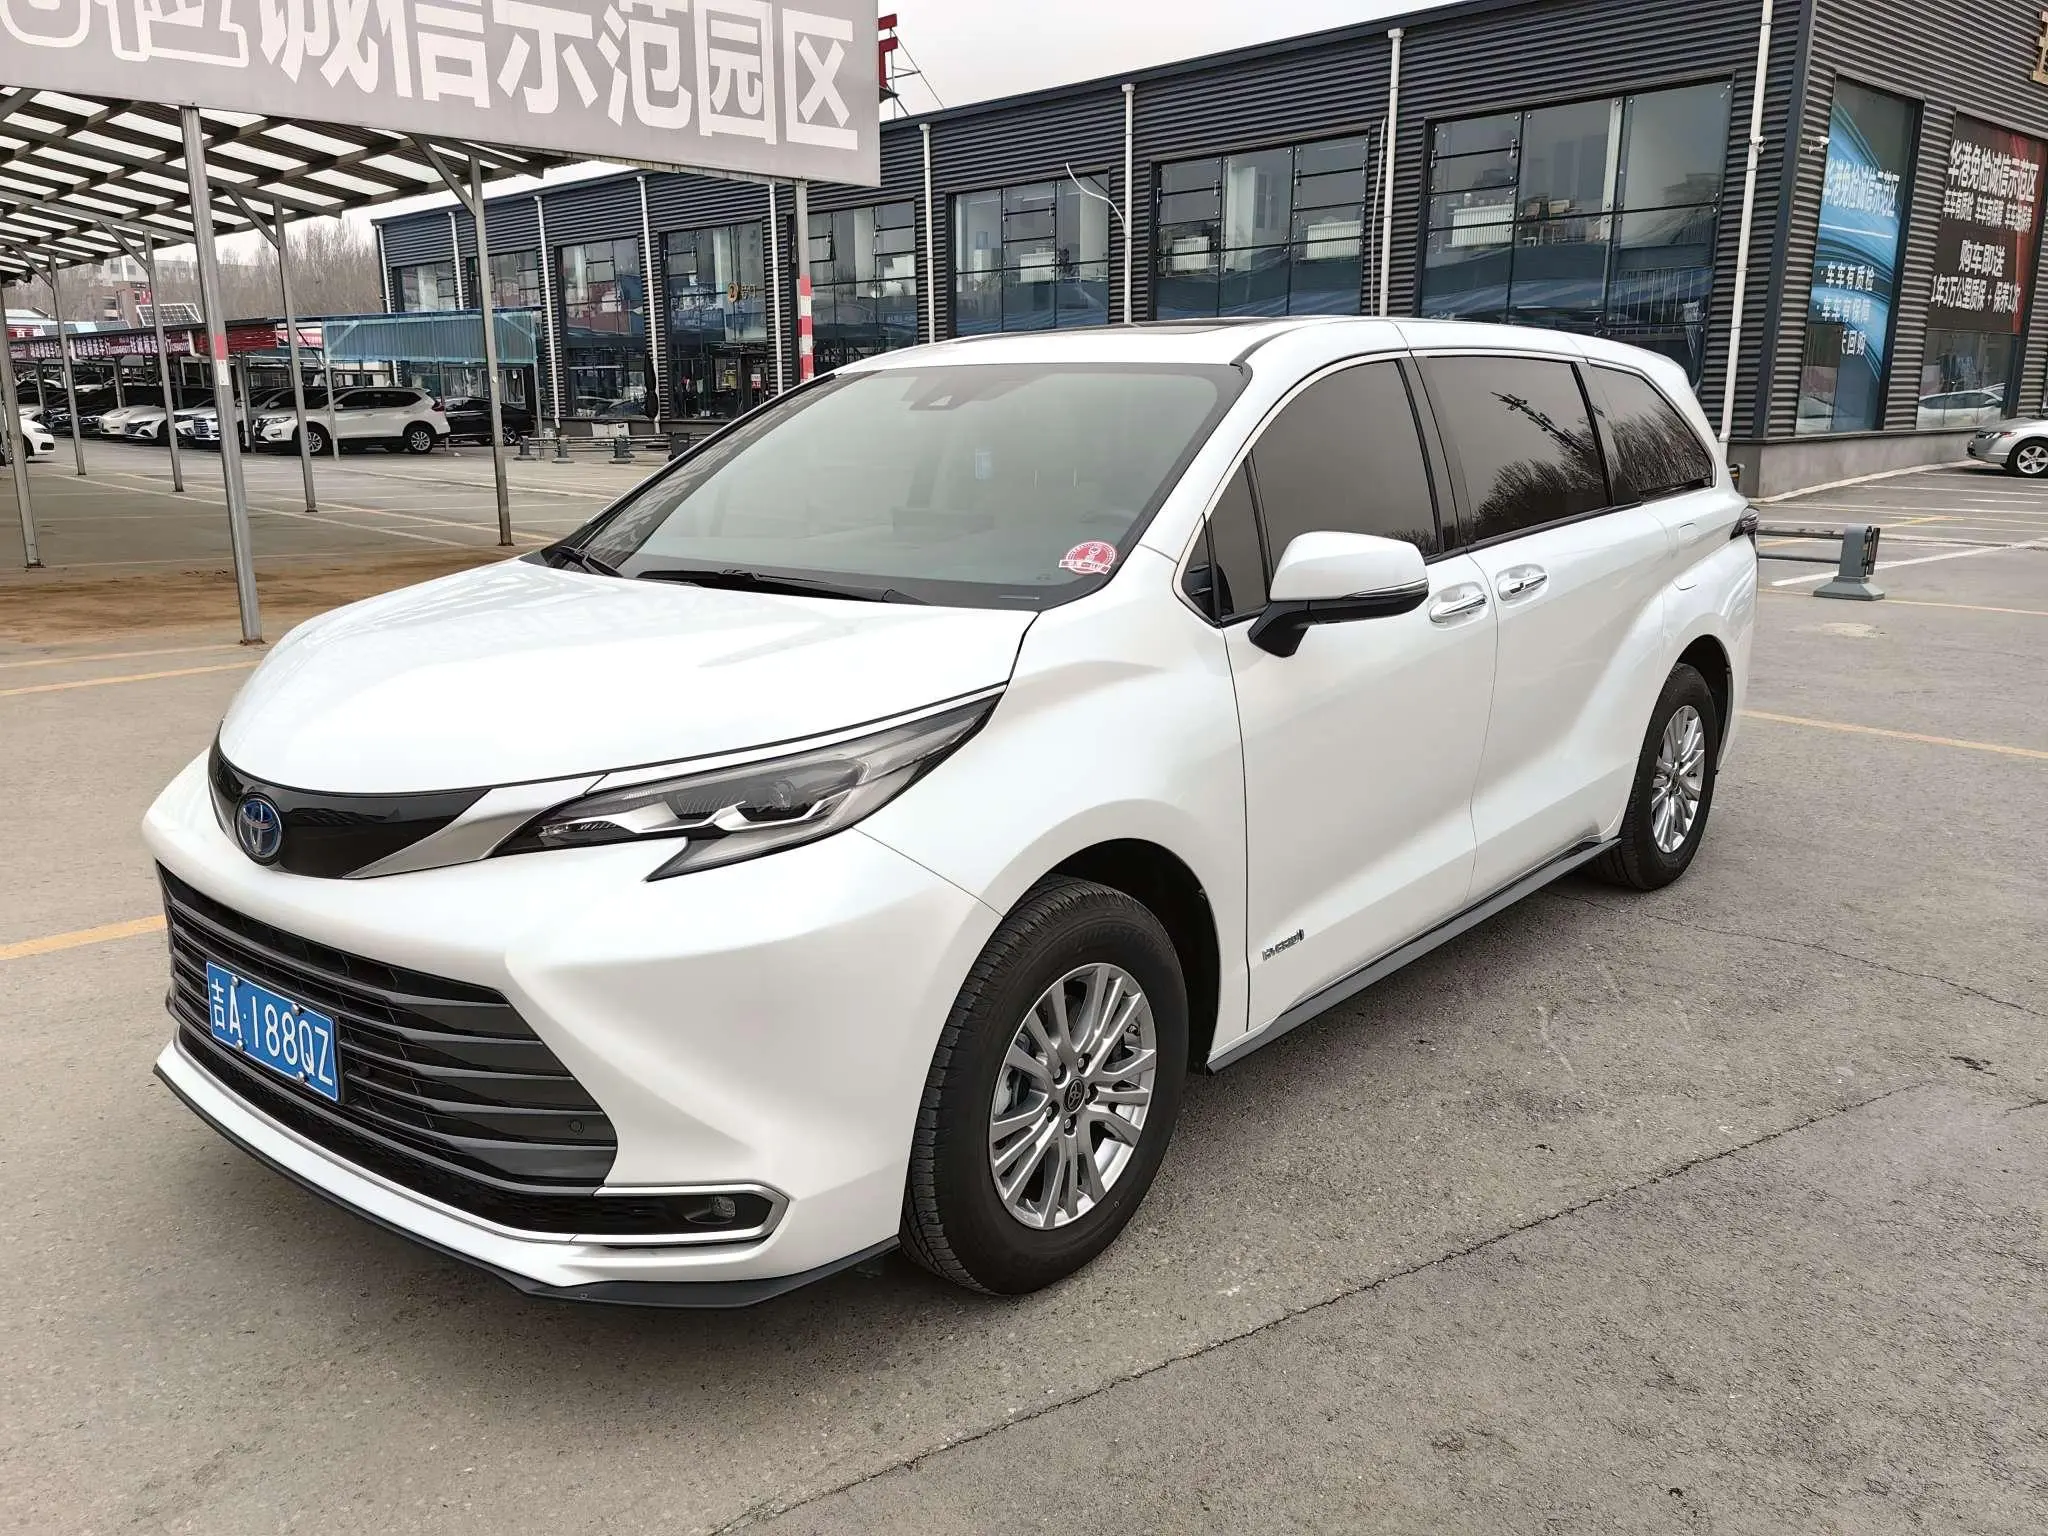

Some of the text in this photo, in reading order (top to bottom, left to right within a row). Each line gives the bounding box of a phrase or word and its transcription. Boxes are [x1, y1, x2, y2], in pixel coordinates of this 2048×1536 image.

[1947, 139, 2038, 202] 华港免检诚信示范区
[1959, 240, 2005, 277] 购车即送
[1826, 262, 1874, 291] 车车有质检
[1821, 296, 1871, 323] 车车有保障
